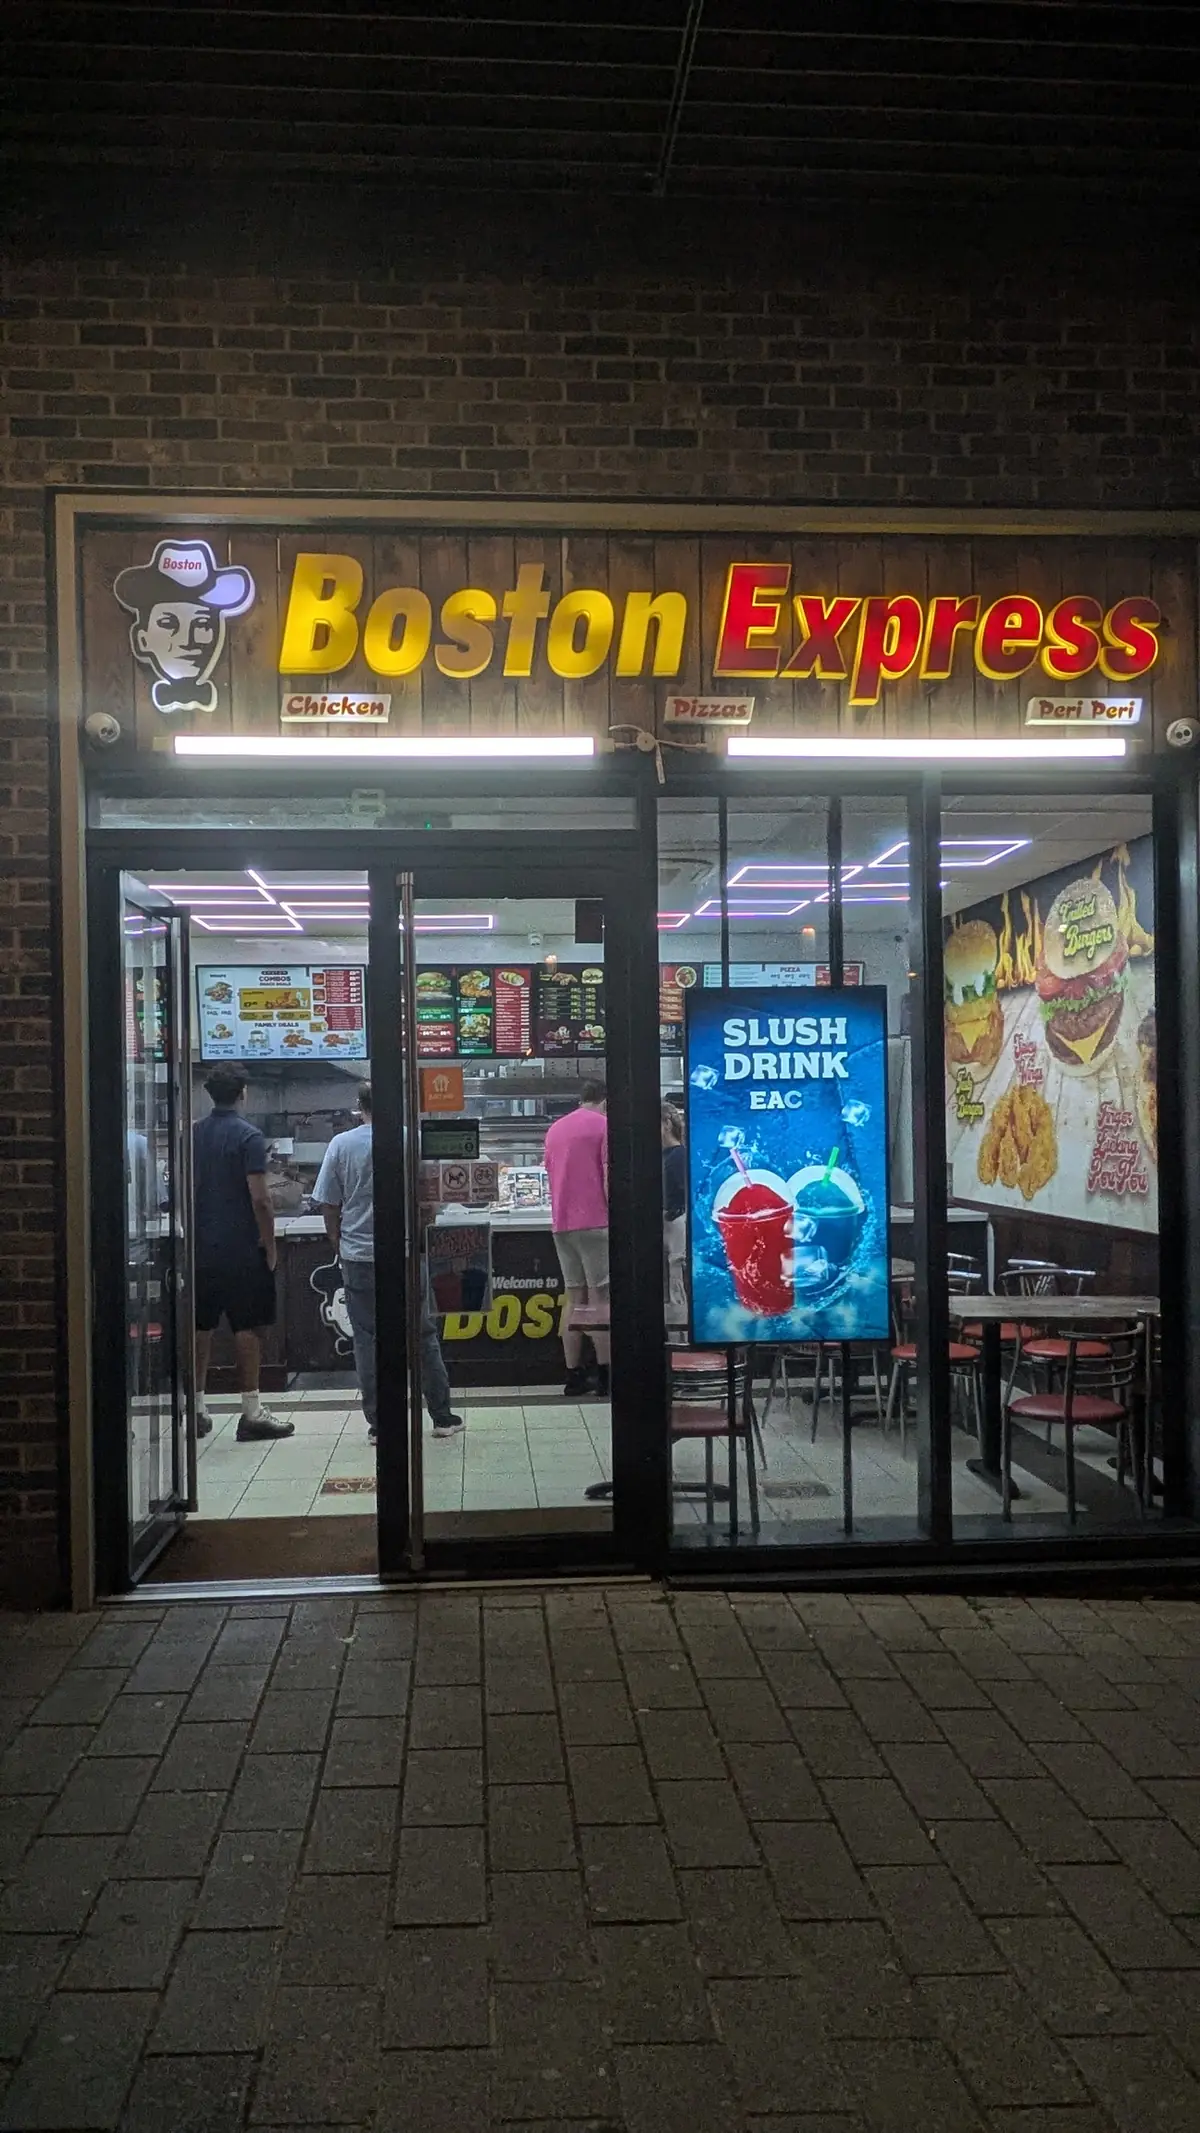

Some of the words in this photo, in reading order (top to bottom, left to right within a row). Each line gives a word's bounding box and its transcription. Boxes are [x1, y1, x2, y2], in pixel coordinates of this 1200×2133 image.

[163, 557, 202, 570] Boston
[279, 552, 688, 679] Boston
[713, 562, 1161, 706] Express
[286, 696, 385, 716] Chicken
[673, 698, 748, 718] Pizzas
[1038, 700, 1084, 719] Peri
[1091, 700, 1136, 719] Peri
[1063, 924, 1113, 959] Burgers
[723, 1017, 847, 1047] SLUSH
[723, 1051, 849, 1080] DRINK
[749, 1090, 803, 1110] EAC
[492, 1276, 543, 1289] Welcome
[546, 1276, 559, 1288] to
